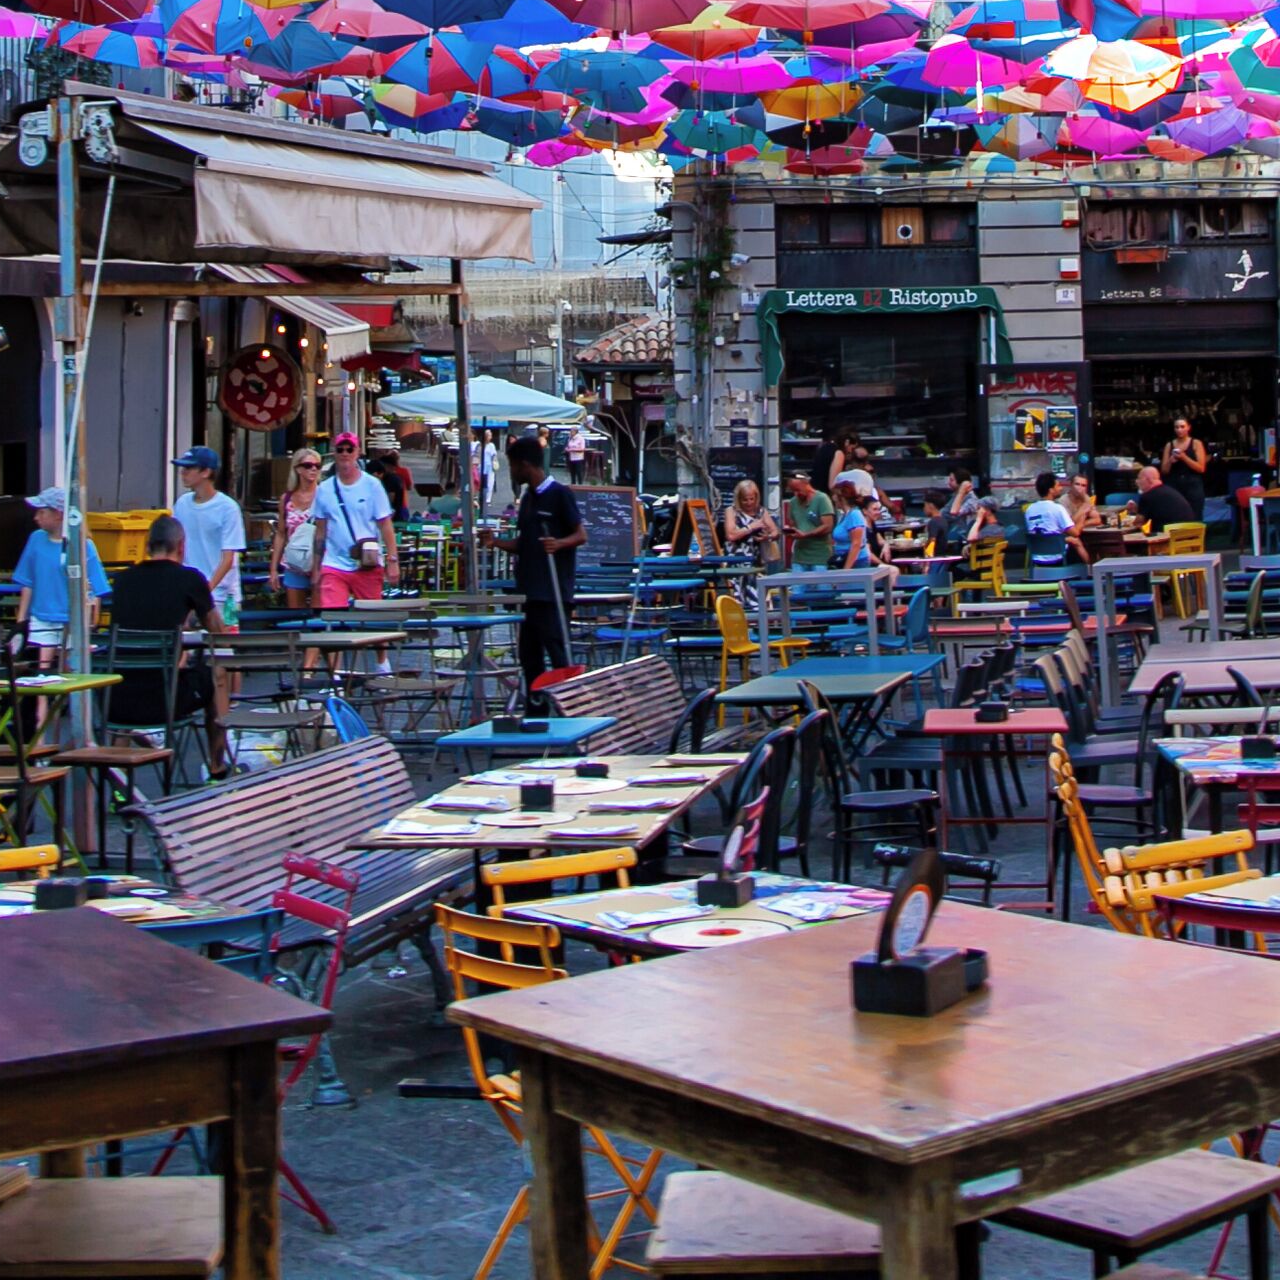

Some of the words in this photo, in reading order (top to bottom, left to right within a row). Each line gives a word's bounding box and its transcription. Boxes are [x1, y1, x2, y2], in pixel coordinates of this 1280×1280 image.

[786, 290, 857, 307] Lettera
[863, 290, 883, 306] 82
[889, 288, 978, 308] Ristopub
[1100, 289, 1145, 300] lettera
[1149, 287, 1163, 299] 82
